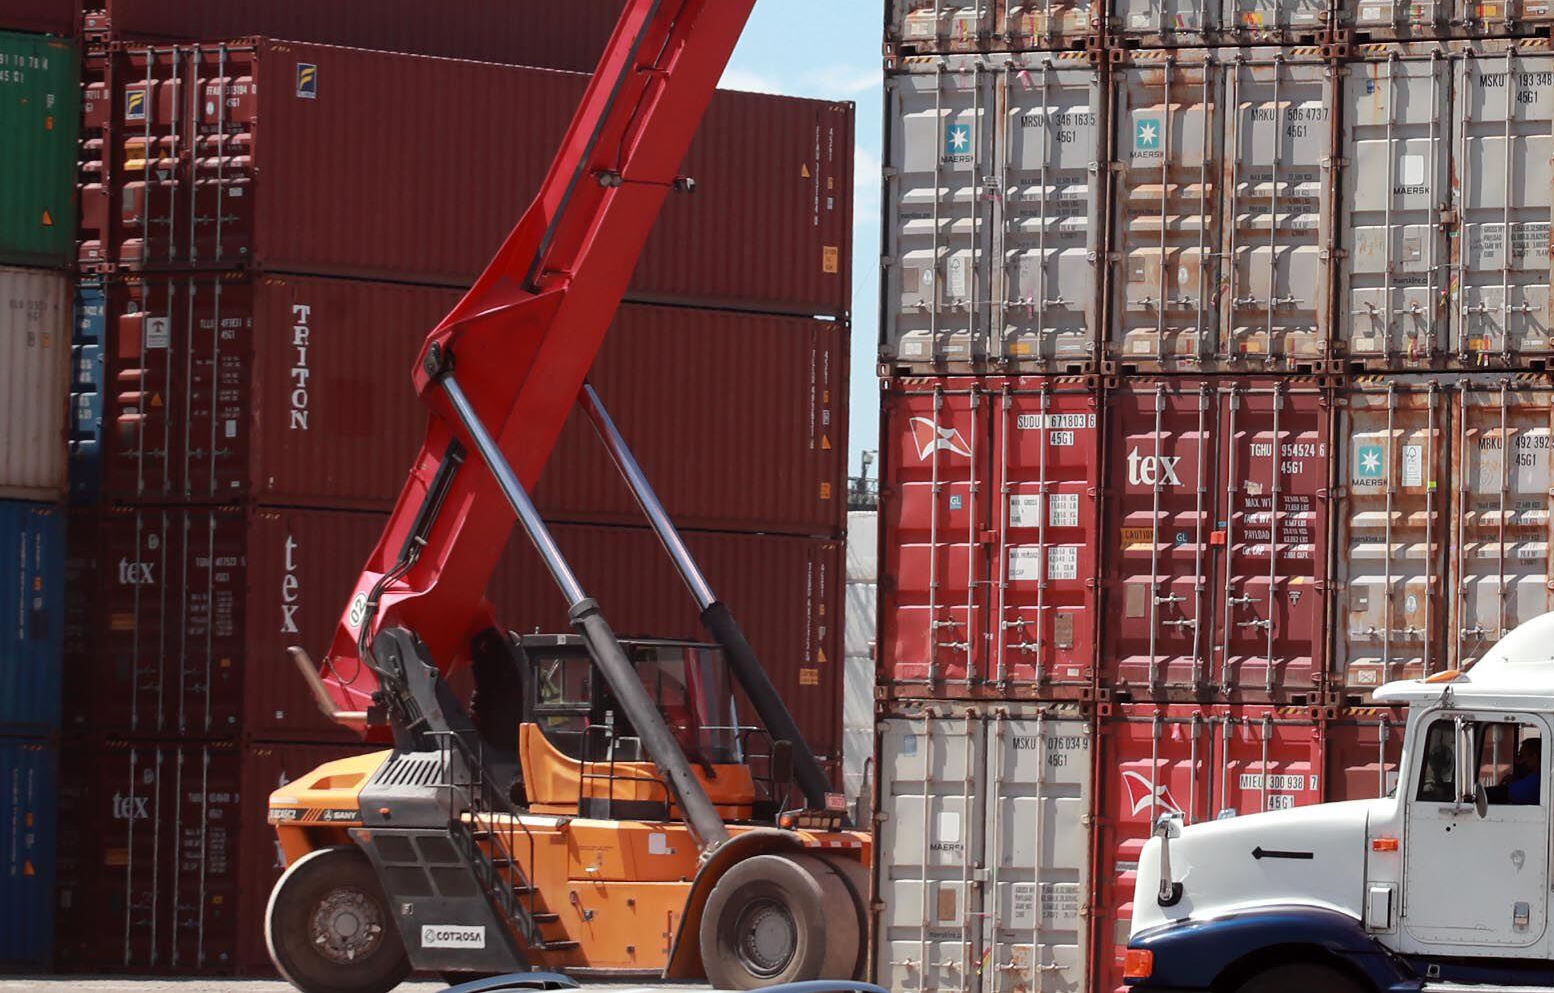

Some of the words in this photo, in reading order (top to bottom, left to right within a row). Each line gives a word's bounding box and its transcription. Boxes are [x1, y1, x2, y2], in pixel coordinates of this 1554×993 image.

[1394, 187, 1430, 195] MAERSK
[290, 304, 311, 430] TRITON
[1127, 446, 1182, 486] tex
[120, 557, 155, 585] tex
[281, 535, 300, 633] tex
[113, 792, 149, 819] tex
[437, 931, 482, 943] COTROSA
